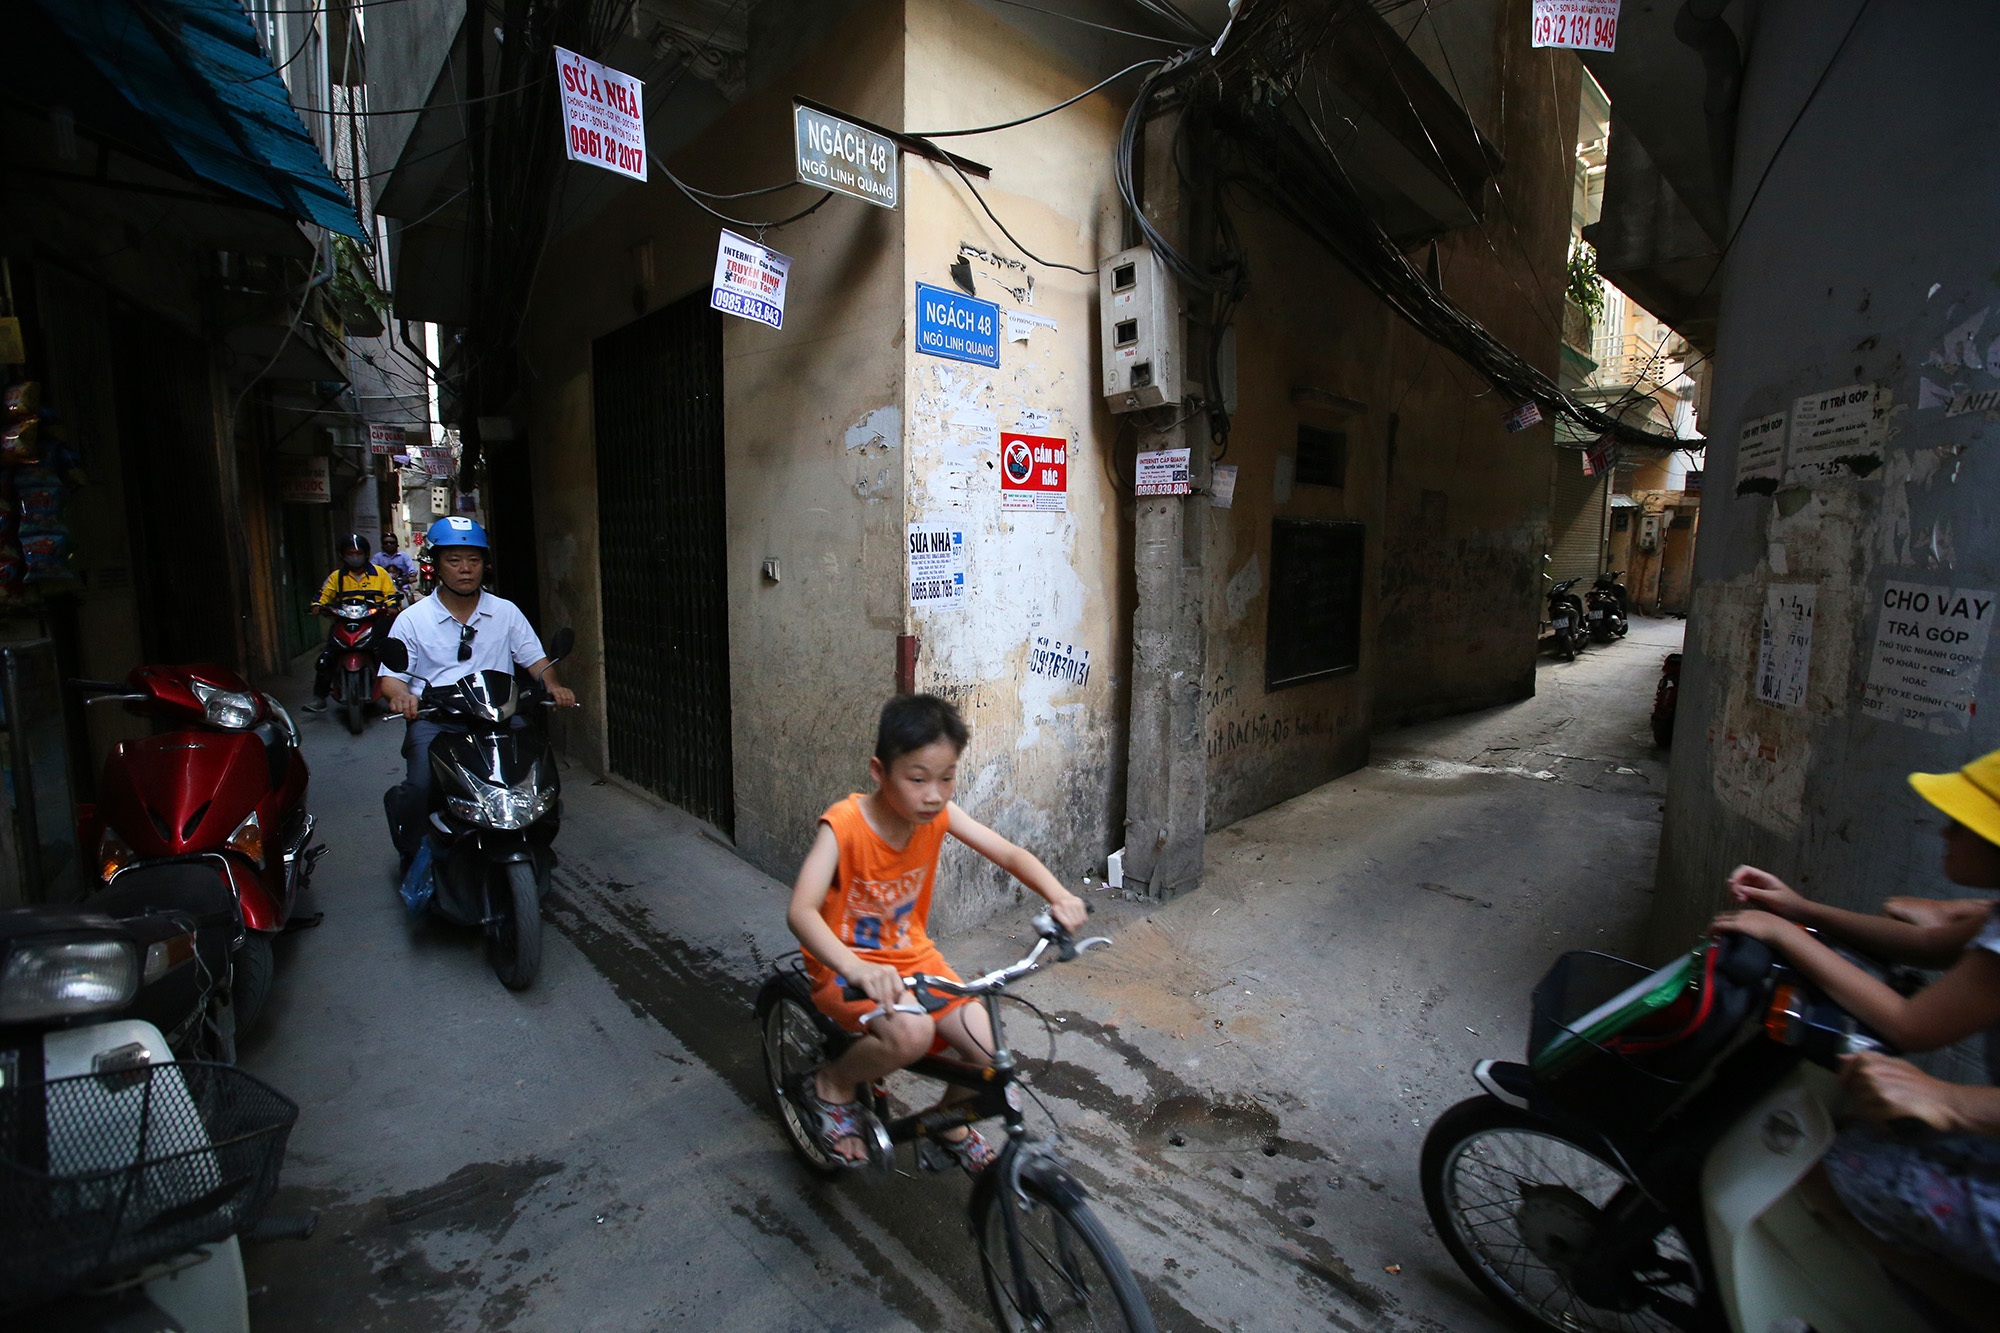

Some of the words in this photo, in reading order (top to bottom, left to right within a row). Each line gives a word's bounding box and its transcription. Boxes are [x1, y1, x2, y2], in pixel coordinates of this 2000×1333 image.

[1534, 14, 1566, 45] 0912
[1570, 14, 1591, 46] 131
[1594, 16, 1615, 48] 949
[563, 55, 603, 103] SỬA
[604, 82, 640, 119] NHÀ
[570, 124, 602, 159] 0961
[604, 135, 616, 165] 28
[618, 142, 643, 174] 2017
[808, 119, 866, 167] NGÁCH
[869, 143, 886, 174] 48
[802, 158, 828, 177] NGÕ
[830, 167, 855, 187] LINH
[857, 176, 893, 199] QUANG
[724, 246, 757, 264] INTERNET
[715, 290, 780, 326] 0985.843.643
[926, 300, 974, 332] NGÁCH
[977, 315, 991, 336] 48
[923, 329, 943, 347] NGÕ
[945, 335, 964, 352] LINH
[965, 340, 994, 358] QUANG
[1830, 391, 1846, 408] TRẢ
[1848, 388, 1869, 404] GÓP
[1042, 467, 1058, 486] RÁC
[910, 526, 928, 554] SỬA
[930, 527, 951, 553] NHÀ
[1884, 588, 1929, 613] CHO
[1937, 594, 1991, 620] VAY
[1888, 620, 1920, 639] TRẢ
[1926, 626, 1969, 645] GÓP
[1914, 647, 1947, 659] NHANH
[1900, 691, 1912, 699] XE
